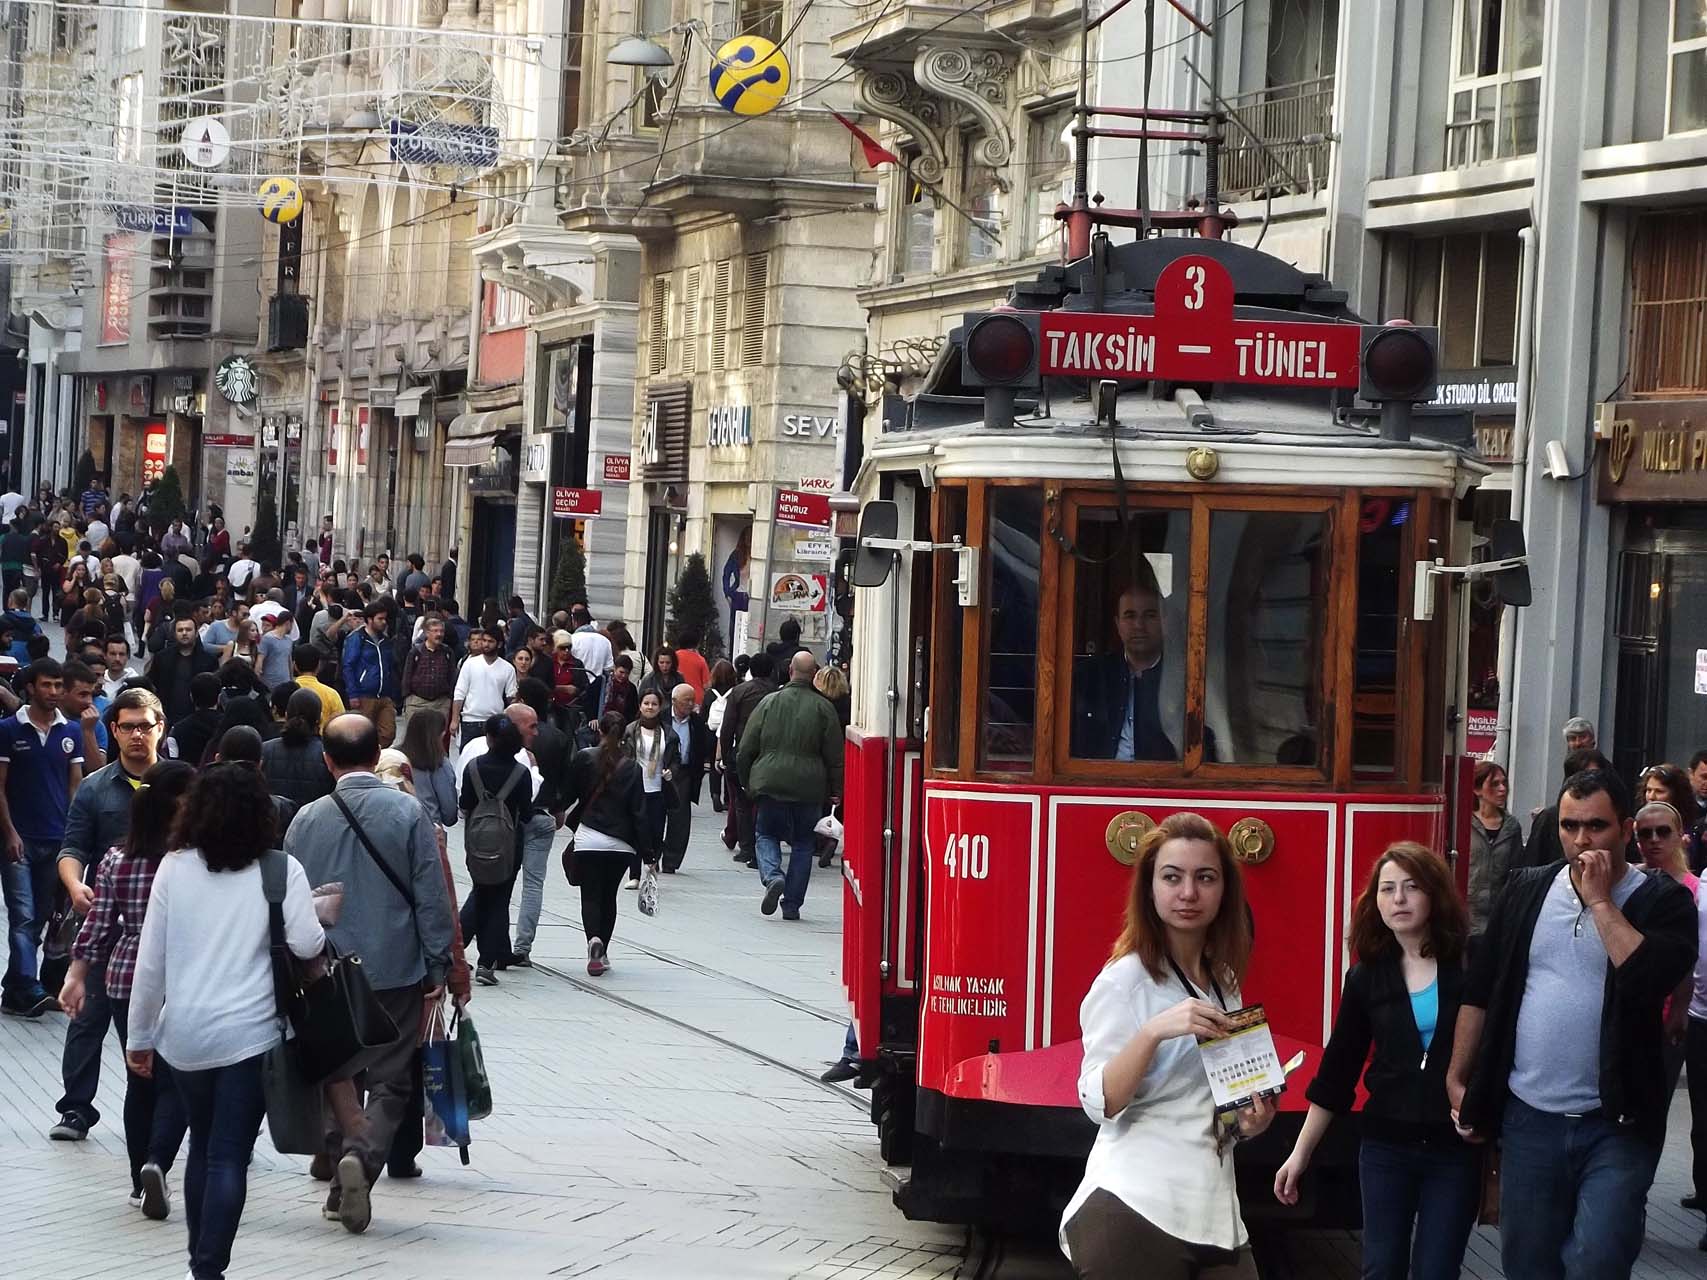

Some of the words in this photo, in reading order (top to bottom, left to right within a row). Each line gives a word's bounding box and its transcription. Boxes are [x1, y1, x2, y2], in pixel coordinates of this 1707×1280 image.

[122, 210, 188, 227] TURKCELL
[1184, 266, 1206, 310] 3
[1046, 326, 1155, 372] TAKSİM
[1234, 332, 1337, 379] TÜNEL
[1446, 383, 1477, 404] STUDIO
[1477, 377, 1491, 403] DİL
[1641, 418, 1685, 470] MİLLİ
[555, 498, 578, 507] GEÇİDİ
[556, 489, 580, 498] OLİVYA
[780, 493, 799, 503] EMİR
[779, 503, 809, 515] NEVRUZ
[944, 833, 989, 879] 410
[966, 976, 1004, 995] YASAK
